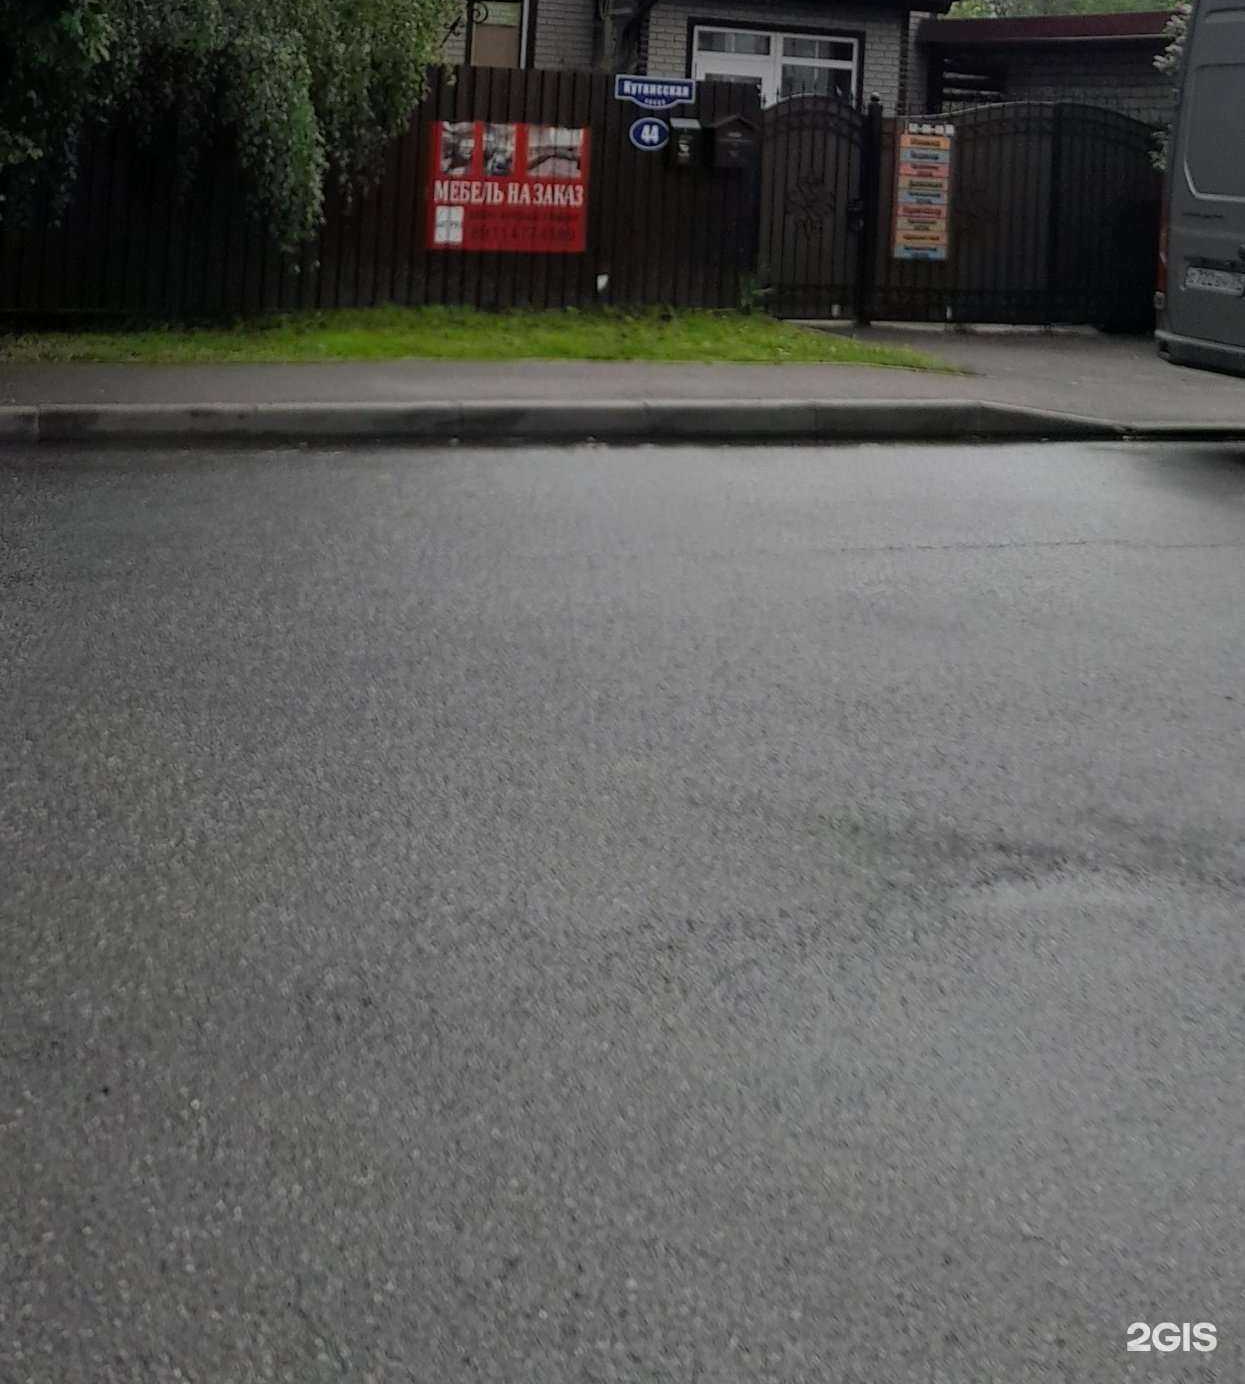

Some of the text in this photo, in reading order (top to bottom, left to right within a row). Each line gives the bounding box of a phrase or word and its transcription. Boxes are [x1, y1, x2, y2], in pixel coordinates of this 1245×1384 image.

[641, 124, 659, 144] 44
[433, 180, 584, 206] МЕБЕЛЬ НА ЗАКАЗ
